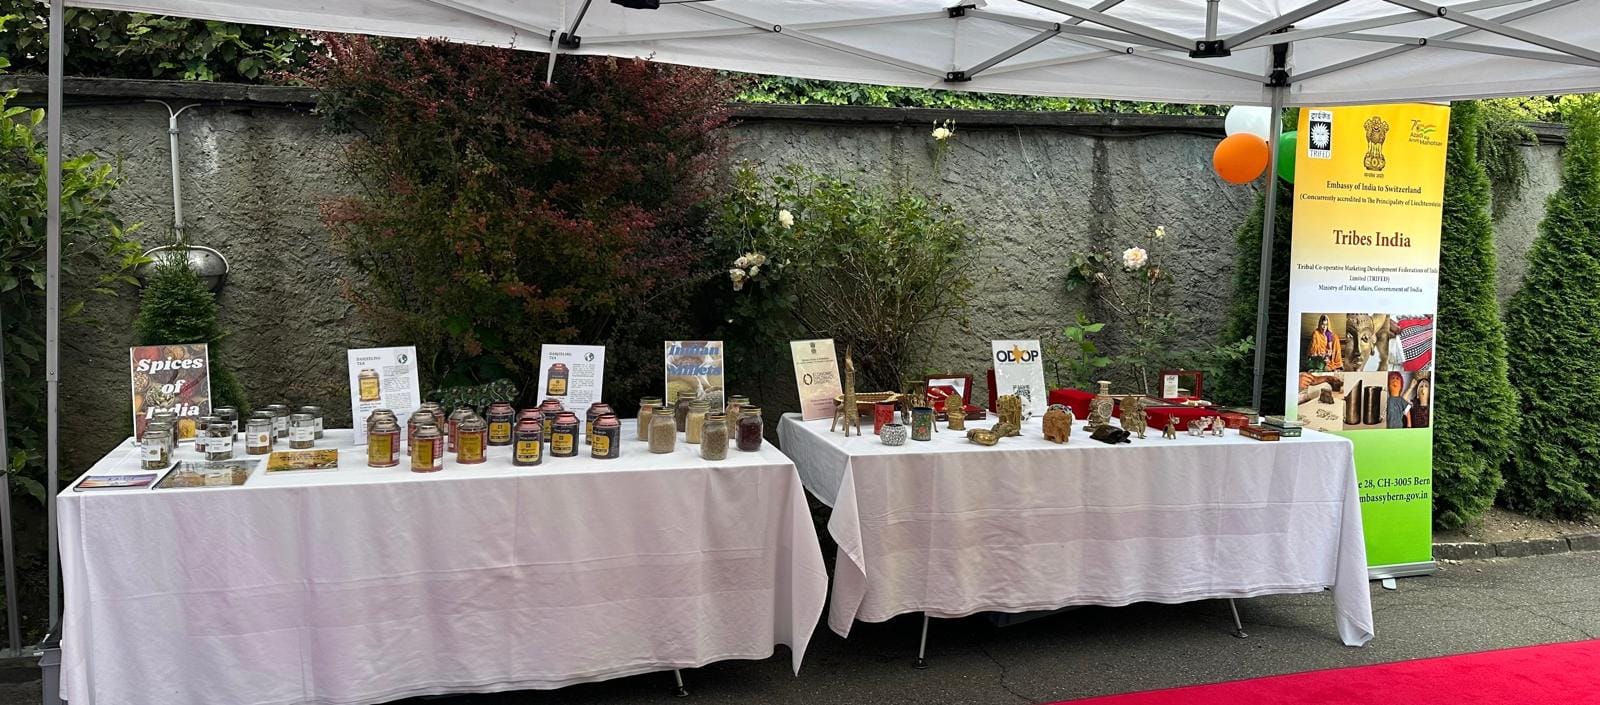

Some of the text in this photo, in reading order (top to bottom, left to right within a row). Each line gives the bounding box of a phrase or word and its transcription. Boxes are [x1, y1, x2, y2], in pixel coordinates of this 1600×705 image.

[1310, 150, 1330, 158] TRIFED
[1327, 181, 1353, 192] Embassy
[1362, 183, 1376, 191] India
[1385, 185, 1422, 194] Switzerland
[1300, 193, 1336, 203] (Concurrently
[1376, 198, 1404, 206] Principality
[1333, 229, 1412, 248] Tribes India
[1315, 264, 1344, 272] Co-operative
[1367, 275, 1390, 283] (TRIFED)
[1318, 284, 1337, 292] Ministry
[136, 356, 204, 375] Spices
[161, 379, 186, 394] of
[1364, 479, 1375, 489] 28,
[1377, 477, 1412, 488] CH-3005
[1414, 476, 1430, 486] Bern
[1359, 490, 1428, 504] mbassybern.gov.in
